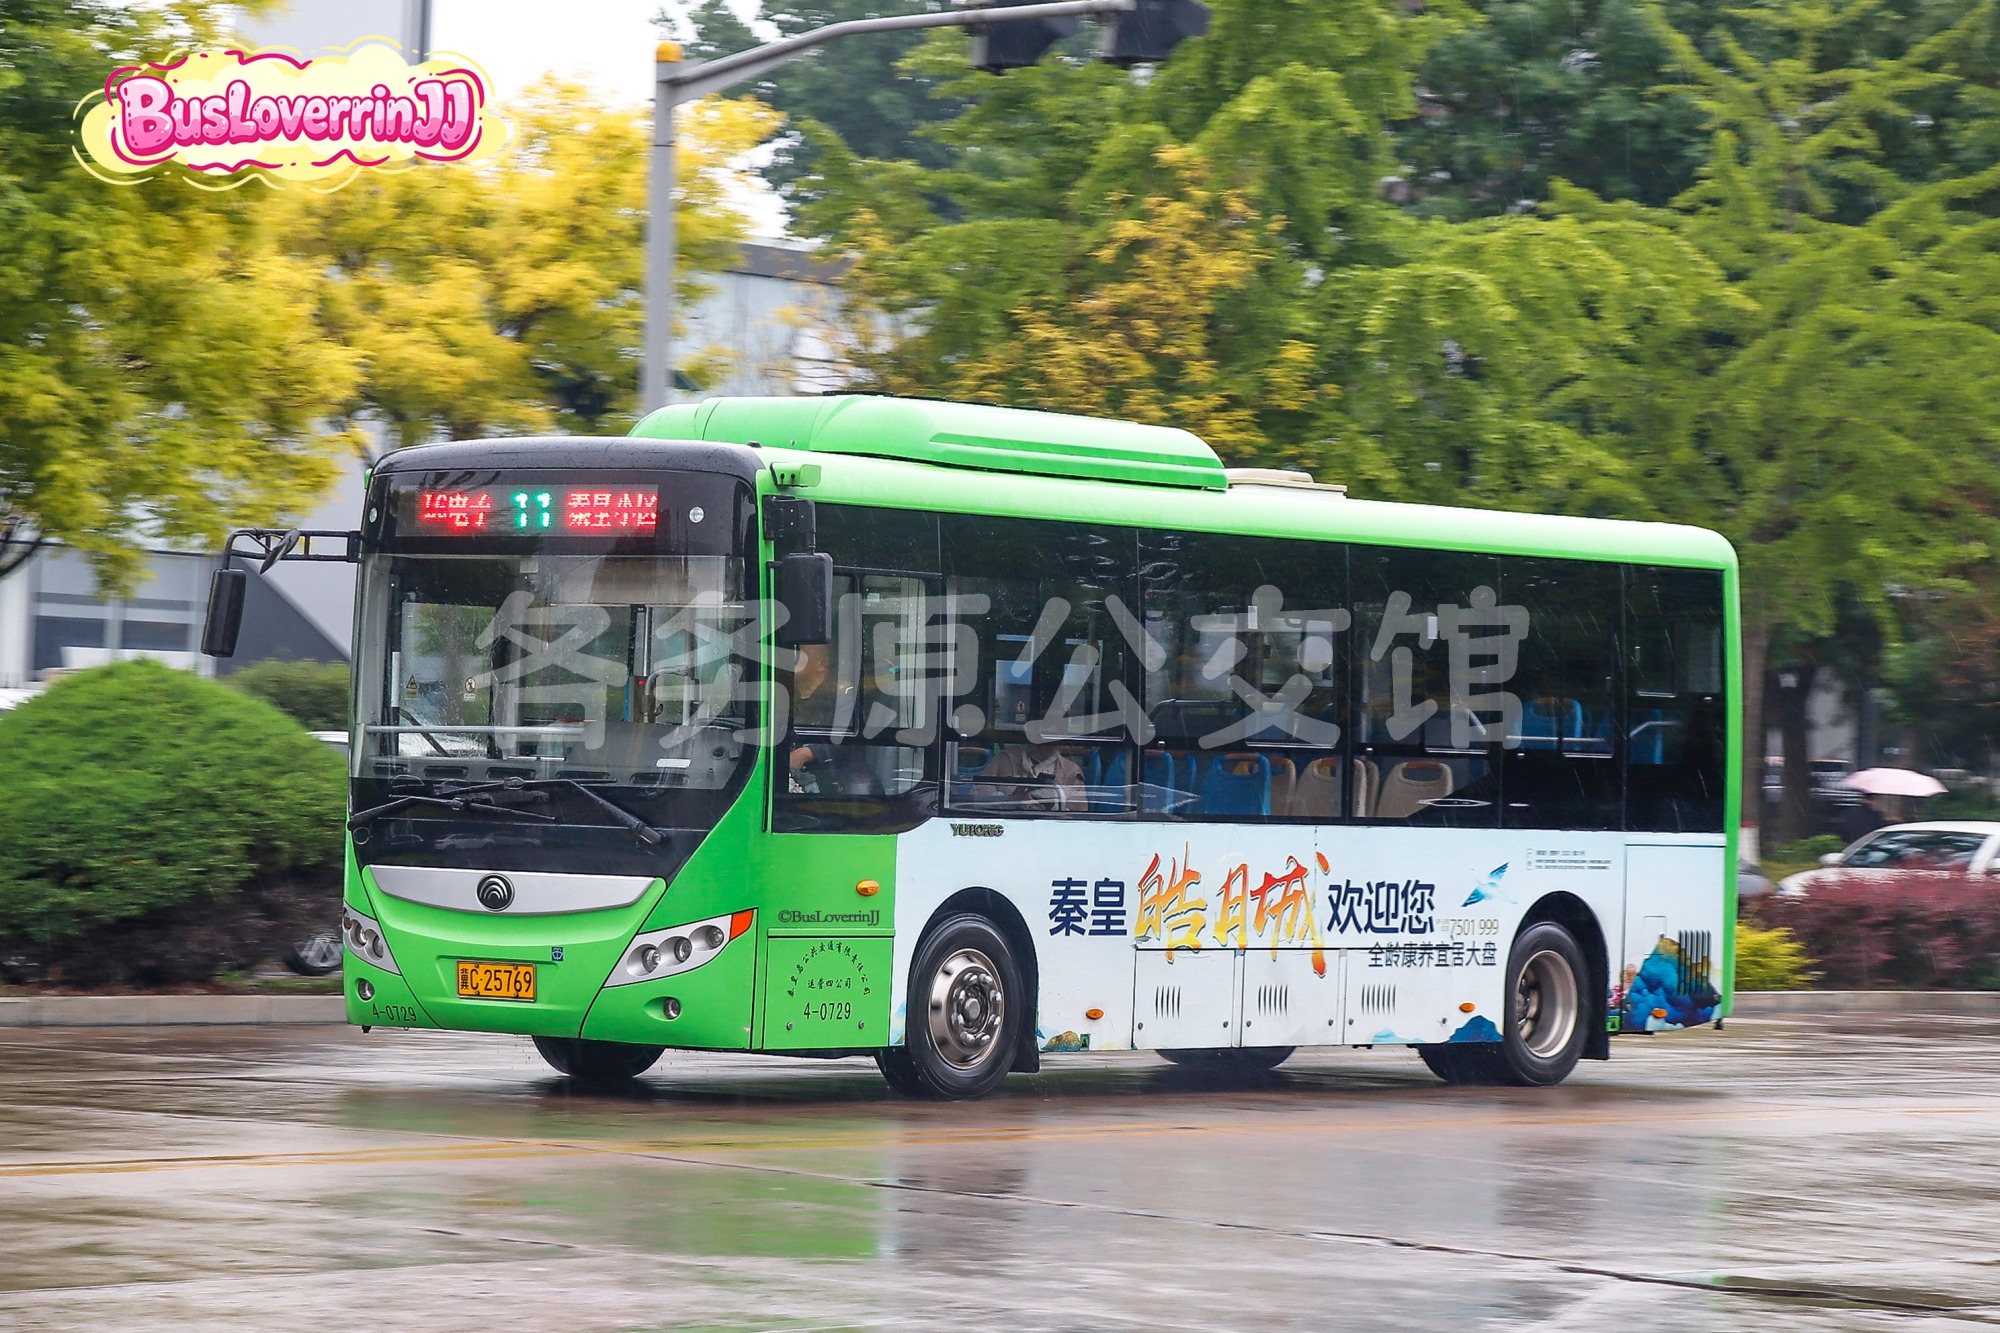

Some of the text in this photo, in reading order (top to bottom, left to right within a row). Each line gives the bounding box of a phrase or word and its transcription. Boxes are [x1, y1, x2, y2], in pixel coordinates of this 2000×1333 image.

[514, 492, 551, 527] 11
[951, 822, 1004, 837] YUTONG
[1326, 878, 1436, 936] 欢迎您
[1479, 918, 1500, 936] 999
[1368, 940, 1498, 968] 全龄康养宜居大盘
[372, 1003, 417, 1022] 4-0729
[803, 1002, 851, 1021] 4-0729
